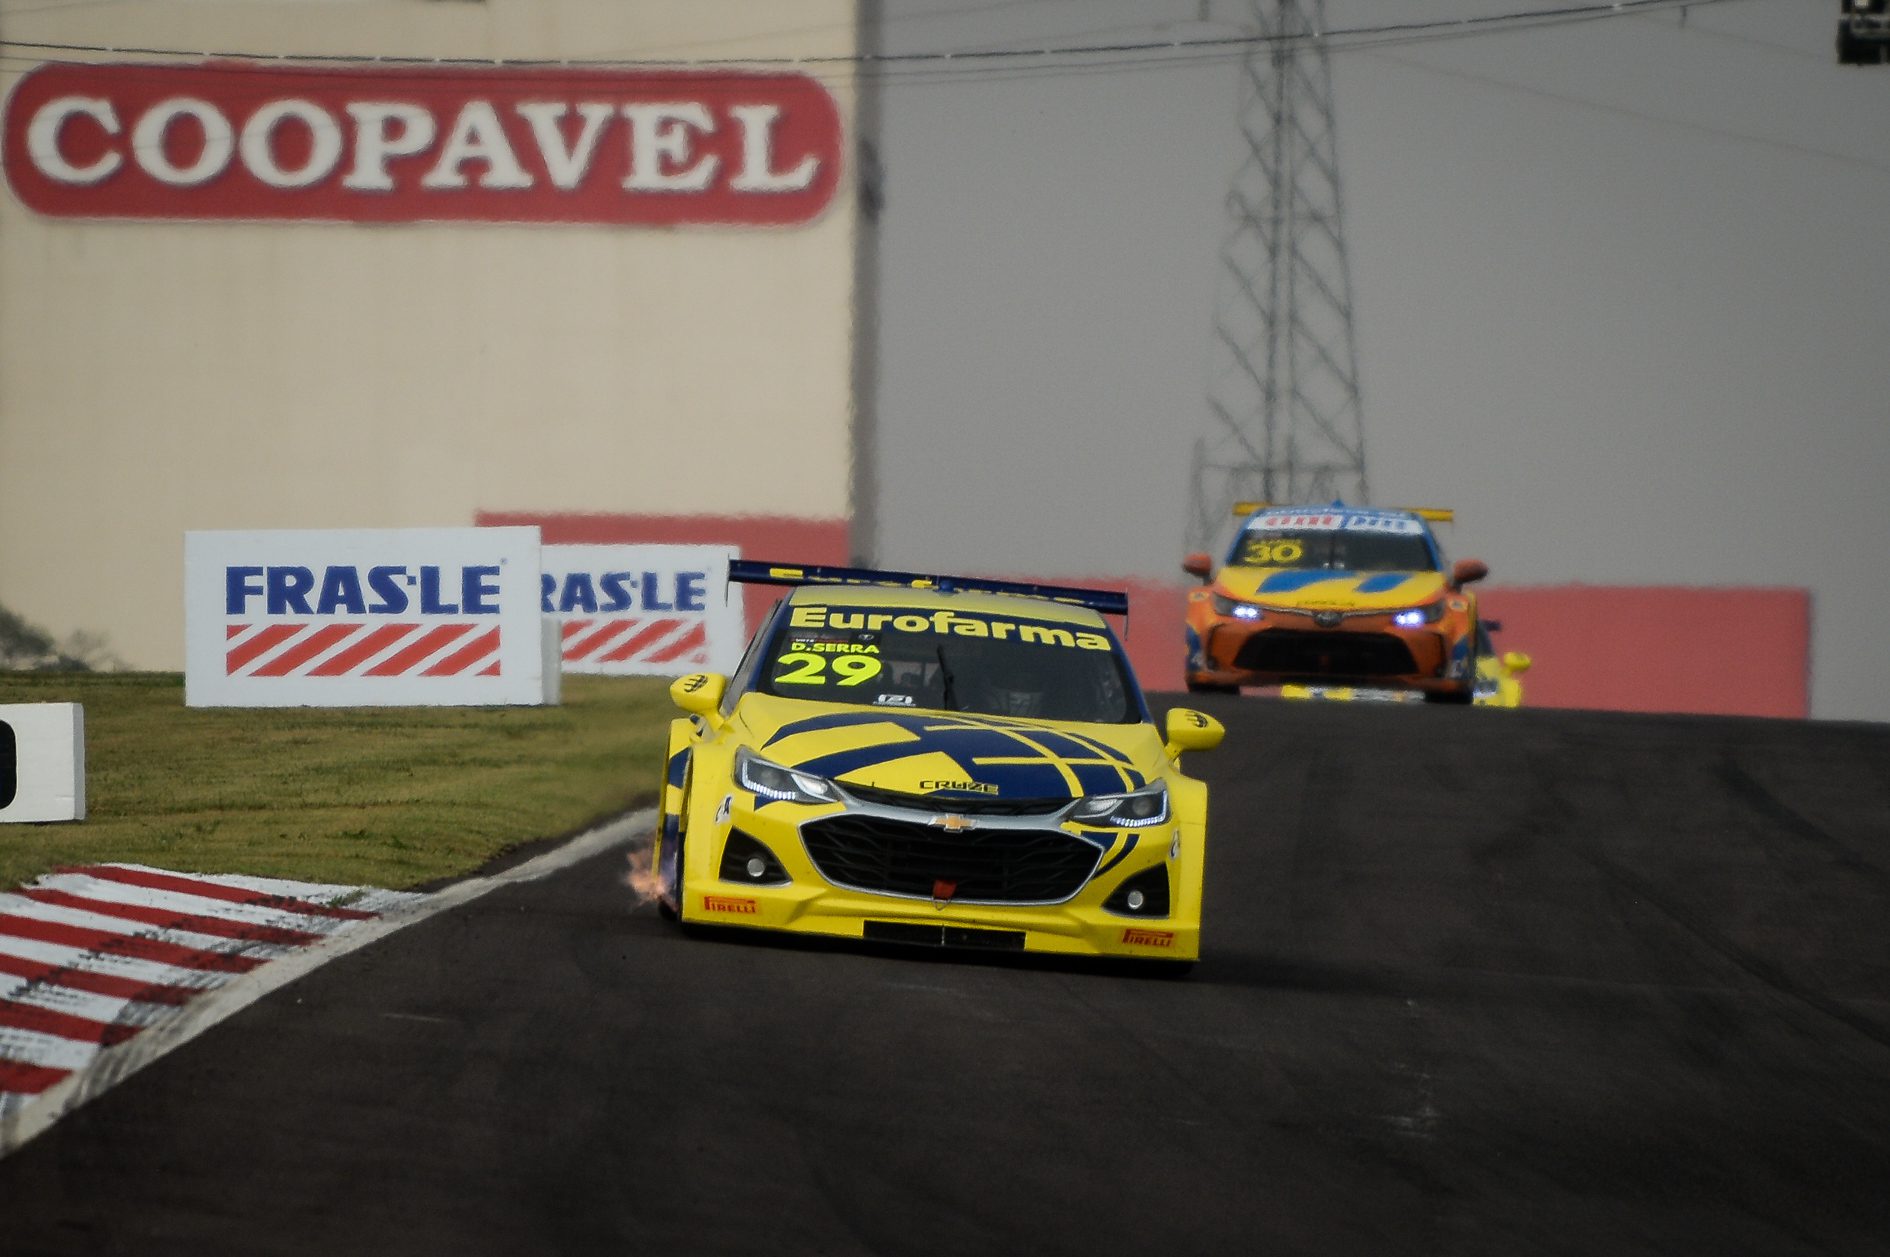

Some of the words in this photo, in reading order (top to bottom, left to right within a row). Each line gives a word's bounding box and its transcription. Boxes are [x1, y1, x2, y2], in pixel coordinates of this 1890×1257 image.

[27, 97, 820, 191] COOPAVEL
[1243, 542, 1304, 563] 30
[790, 606, 1112, 651] Eurofarma
[791, 642, 880, 654] D.SERRA
[774, 652, 882, 686] 29
[919, 780, 999, 795] CRUZE
[703, 896, 757, 913] PIRELLI
[1122, 928, 1174, 947] PIRELLI
